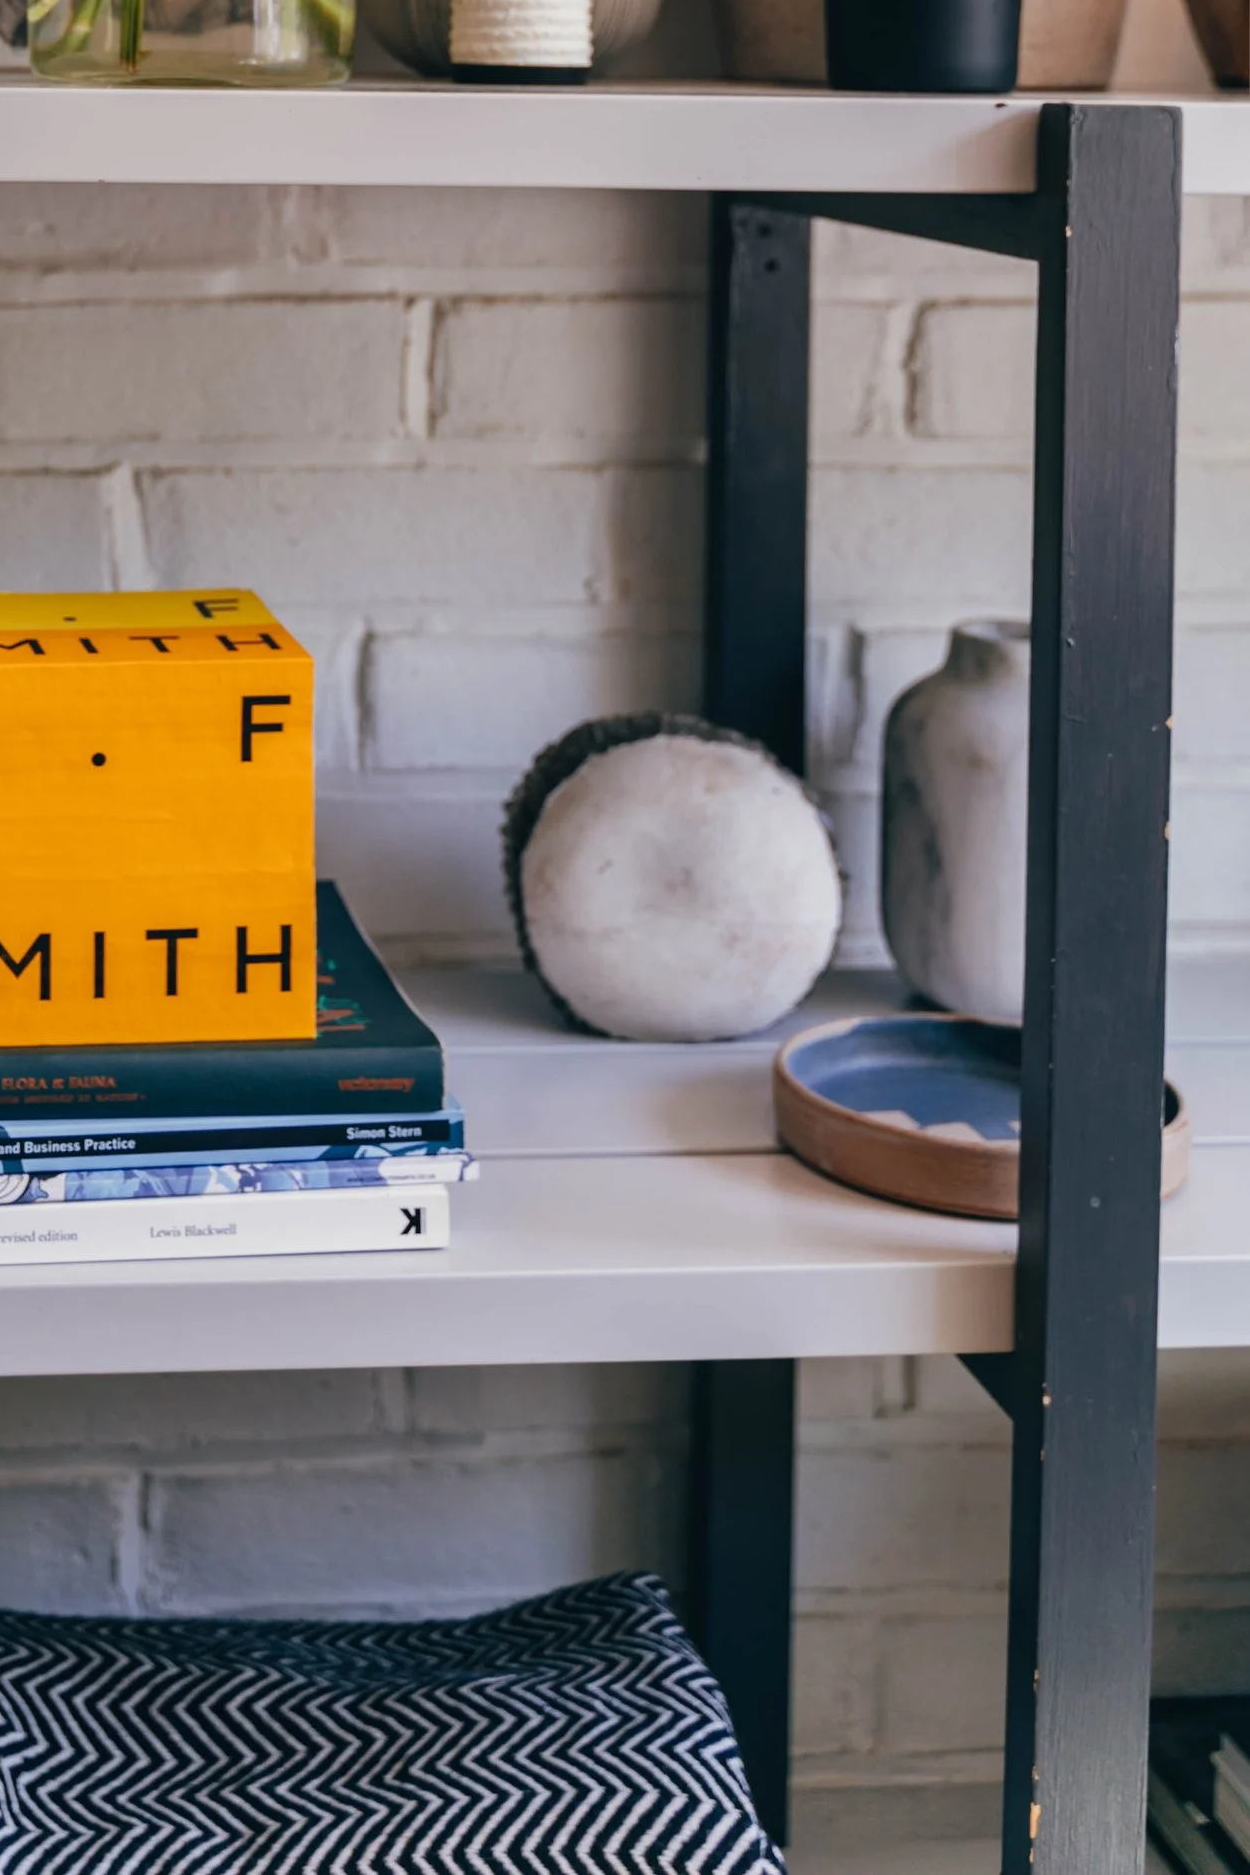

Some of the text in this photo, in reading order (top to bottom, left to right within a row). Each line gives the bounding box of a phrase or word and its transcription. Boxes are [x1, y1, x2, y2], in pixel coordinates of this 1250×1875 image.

[240, 695, 292, 763] F
[1, 1076, 48, 1090] FLORA
[346, 1125, 422, 1141] Simon Stern
[24, 1140, 81, 1154] Business
[84, 1137, 137, 1151] Practice
[38, 1229, 78, 1243] edition
[150, 1223, 237, 1239] Lewis Blackwell
